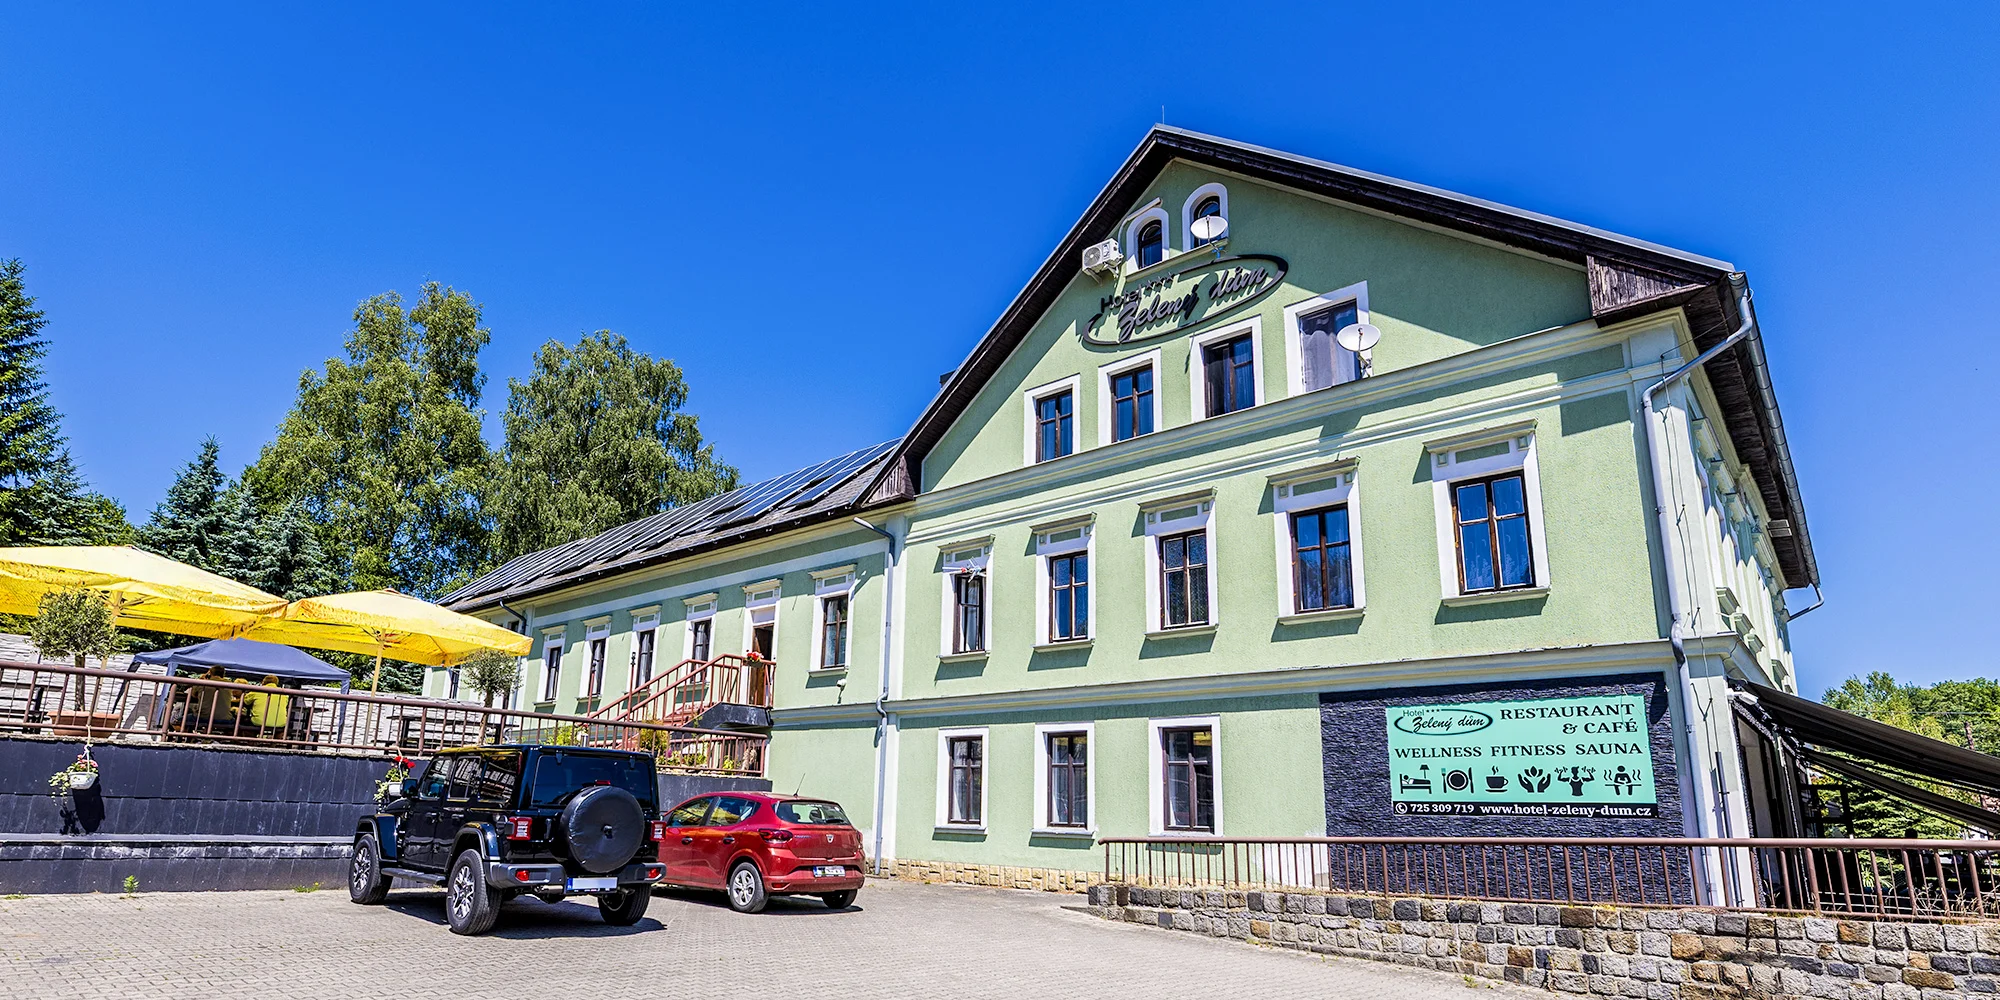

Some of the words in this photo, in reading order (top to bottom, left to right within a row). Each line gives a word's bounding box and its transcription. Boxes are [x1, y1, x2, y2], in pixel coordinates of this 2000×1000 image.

[1101, 284, 1142, 313] Hotel
[1118, 284, 1199, 342] Zelený
[1209, 266, 1268, 299] dům
[1403, 709, 1425, 717] Hotel
[1500, 703, 1635, 720] RESTAURANT
[1412, 716, 1453, 734] Zelený
[1457, 715, 1486, 727] dům
[1562, 723, 1578, 734] &
[1584, 719, 1639, 734] CAFÉ
[1394, 746, 1482, 759] WELLNESS
[1490, 744, 1566, 757] FITNESS
[1575, 742, 1643, 756] SAUNA
[1410, 803, 1430, 813] 725
[1432, 803, 1452, 813] 309
[1453, 804, 1475, 814] 719
[1479, 803, 1652, 817] www.hotel-zeleny-dum.cz
